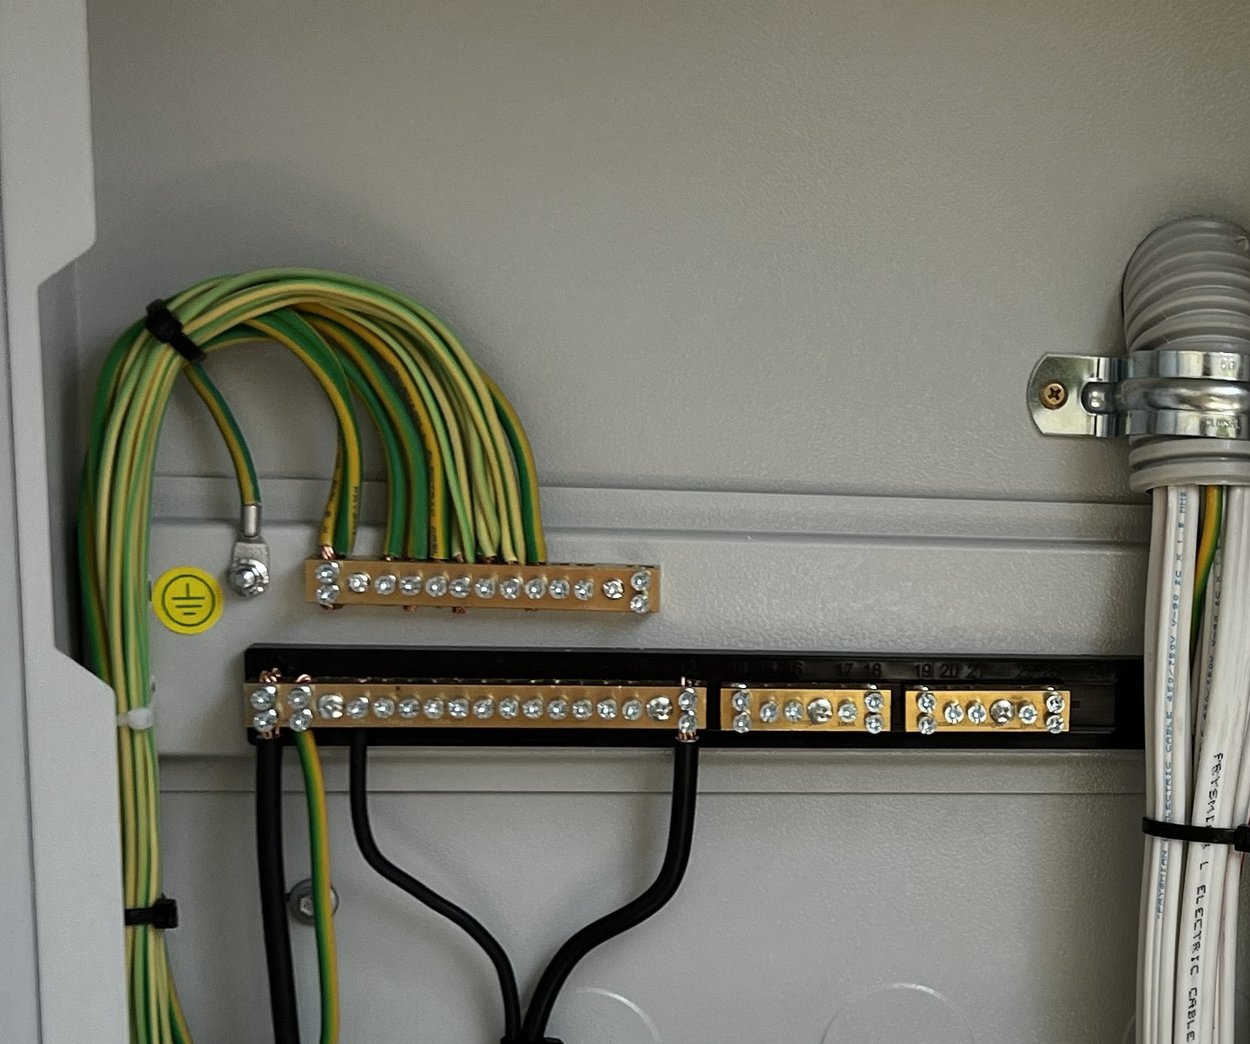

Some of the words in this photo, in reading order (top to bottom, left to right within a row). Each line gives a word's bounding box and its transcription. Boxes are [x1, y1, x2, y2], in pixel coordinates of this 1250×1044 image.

[837, 662, 854, 677] 17
[864, 662, 882, 678] 18
[914, 662, 932, 678] 19
[940, 662, 958, 678] 20
[1189, 884, 1207, 976] ELECTRIC
[1185, 987, 1198, 1043] CABLE
